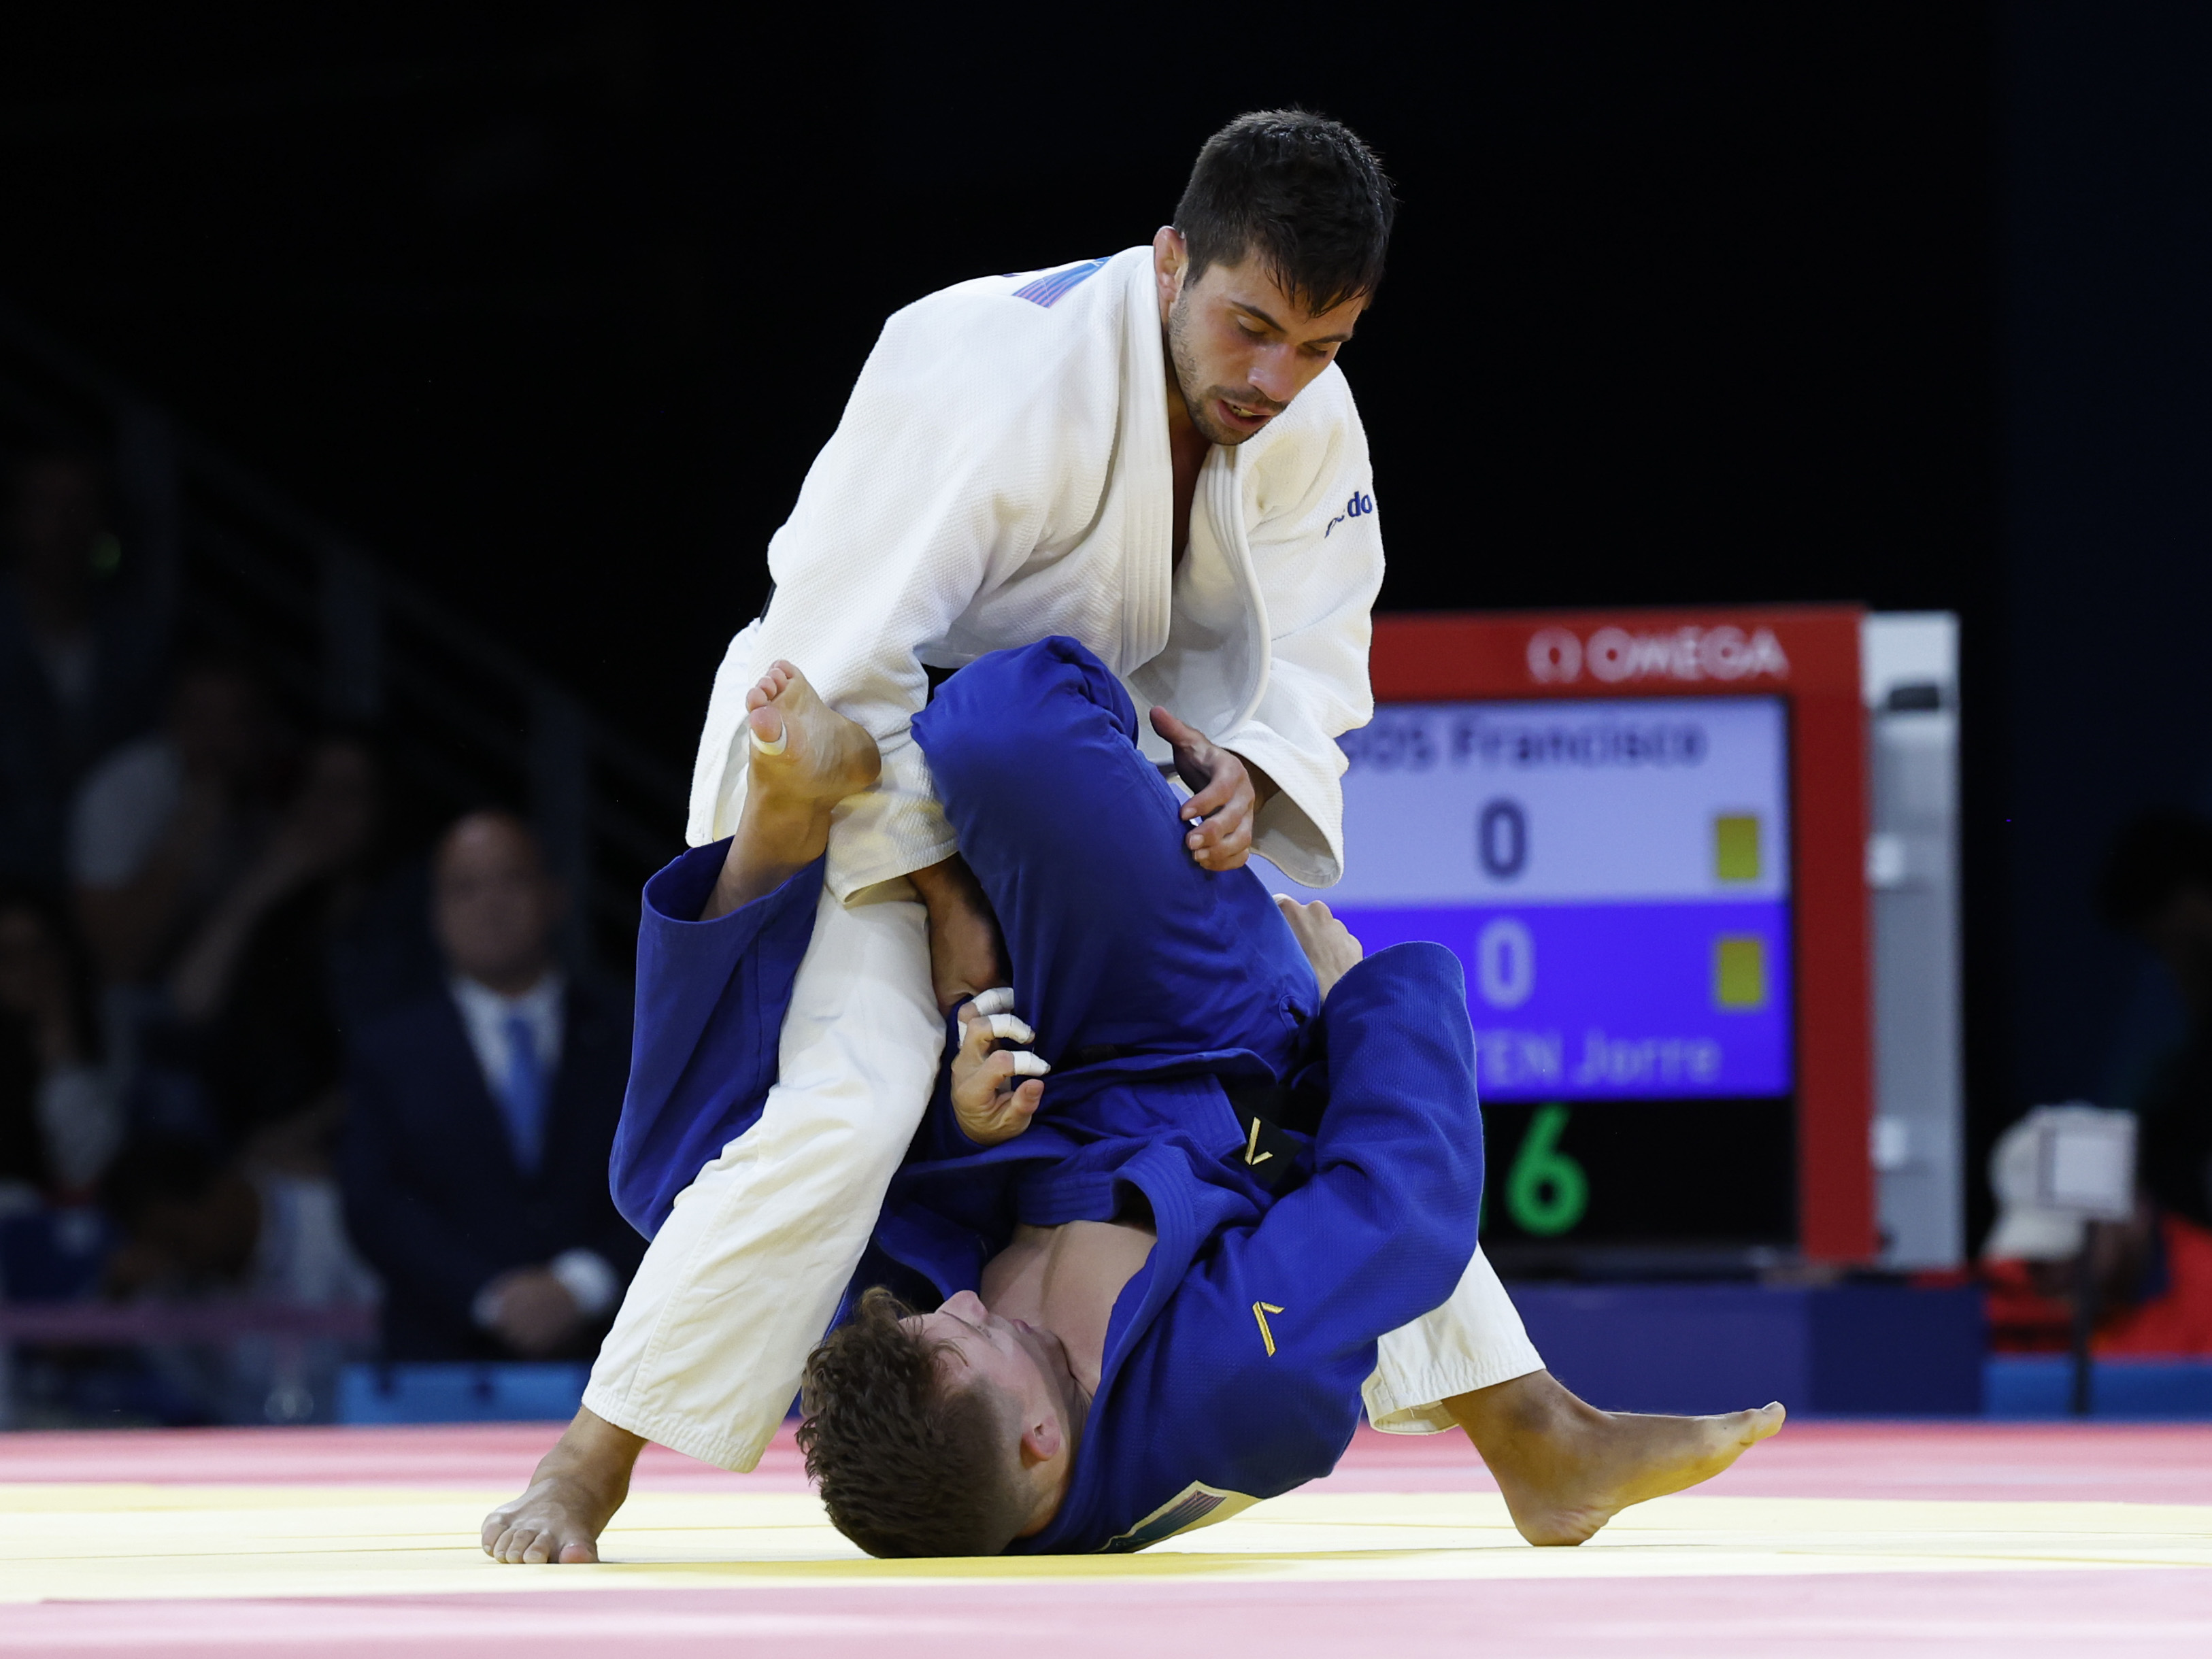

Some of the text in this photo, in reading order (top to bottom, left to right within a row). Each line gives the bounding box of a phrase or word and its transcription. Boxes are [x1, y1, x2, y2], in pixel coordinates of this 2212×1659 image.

[1586, 626, 1789, 682] OMEGA
[1452, 716, 1707, 769] Francisco
[1477, 797, 1528, 878] 0
[1476, 916, 1535, 1009] 0
[1478, 1102, 1592, 1237] 6
